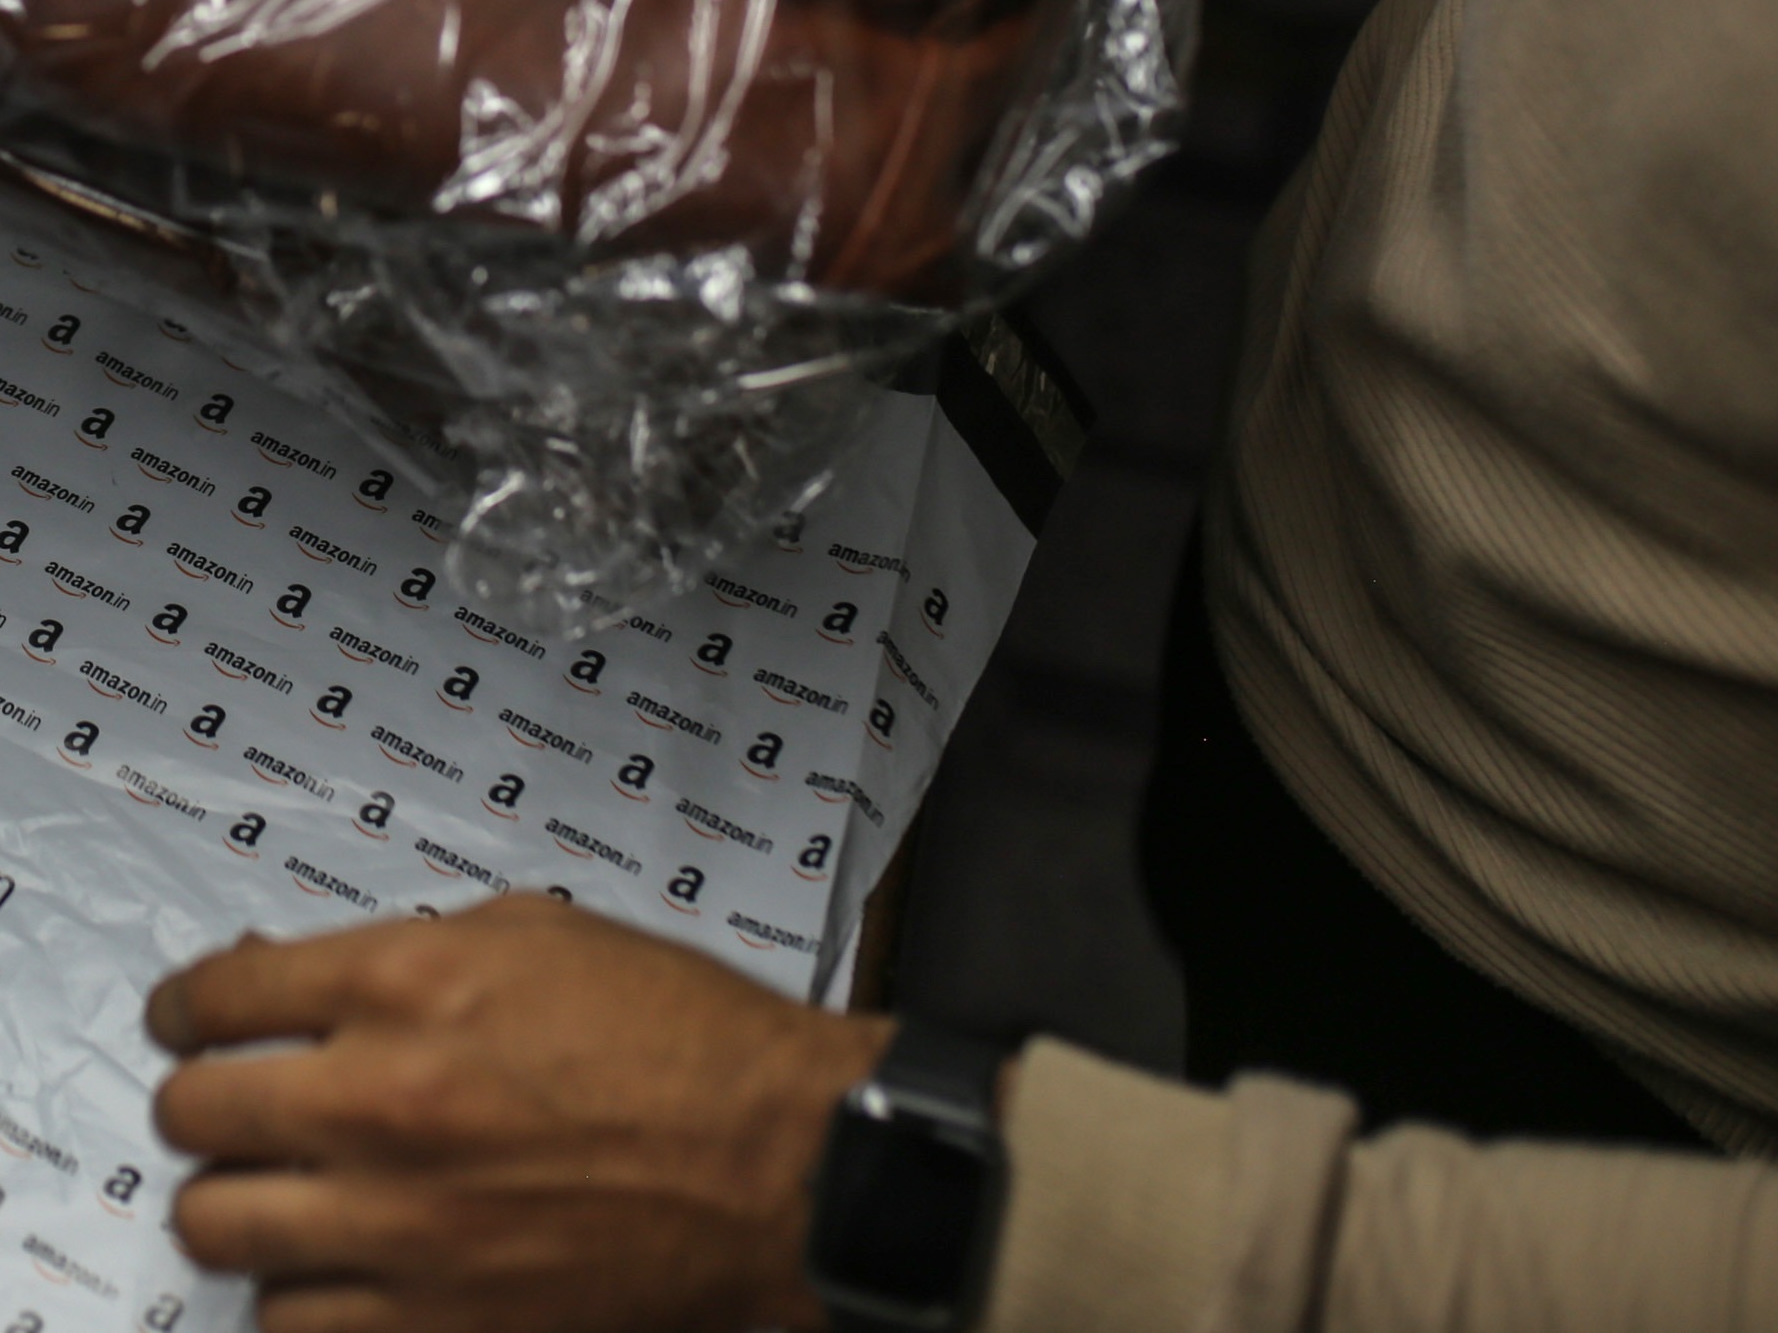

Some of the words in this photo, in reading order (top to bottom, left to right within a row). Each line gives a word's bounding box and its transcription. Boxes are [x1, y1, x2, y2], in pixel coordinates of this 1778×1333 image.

[95, 351, 179, 401] amazon.in
[200, 394, 235, 424] a
[130, 447, 216, 497] amazon.in
[250, 432, 337, 480] amazon.in
[11, 466, 95, 514] amazon.in
[166, 543, 254, 594] amazon.in
[289, 526, 377, 576] amazon.in
[827, 543, 911, 584] amazon.in
[44, 561, 130, 611] amazon.in
[705, 569, 799, 619] amazon.in
[925, 588, 949, 626] a
[28, 619, 64, 653] a
[329, 627, 419, 675] amazon.in
[454, 606, 546, 660] amazon.in
[696, 632, 733, 667] a
[79, 660, 167, 715] amazon.in
[204, 642, 293, 695] amazon.in
[753, 669, 849, 714] amazon.in
[876, 622, 939, 711] amazon.in
[190, 704, 226, 739] a
[498, 708, 593, 764] amazon.in
[626, 691, 722, 745] amazon.in
[243, 747, 335, 802] amazon.in
[370, 726, 464, 783] amazon.in
[617, 754, 655, 790] a
[117, 765, 207, 822] amazon.in
[545, 818, 642, 875] amazon.in
[675, 798, 773, 853] amazon.in
[414, 838, 510, 894] amazon.in
[667, 865, 706, 904] a
